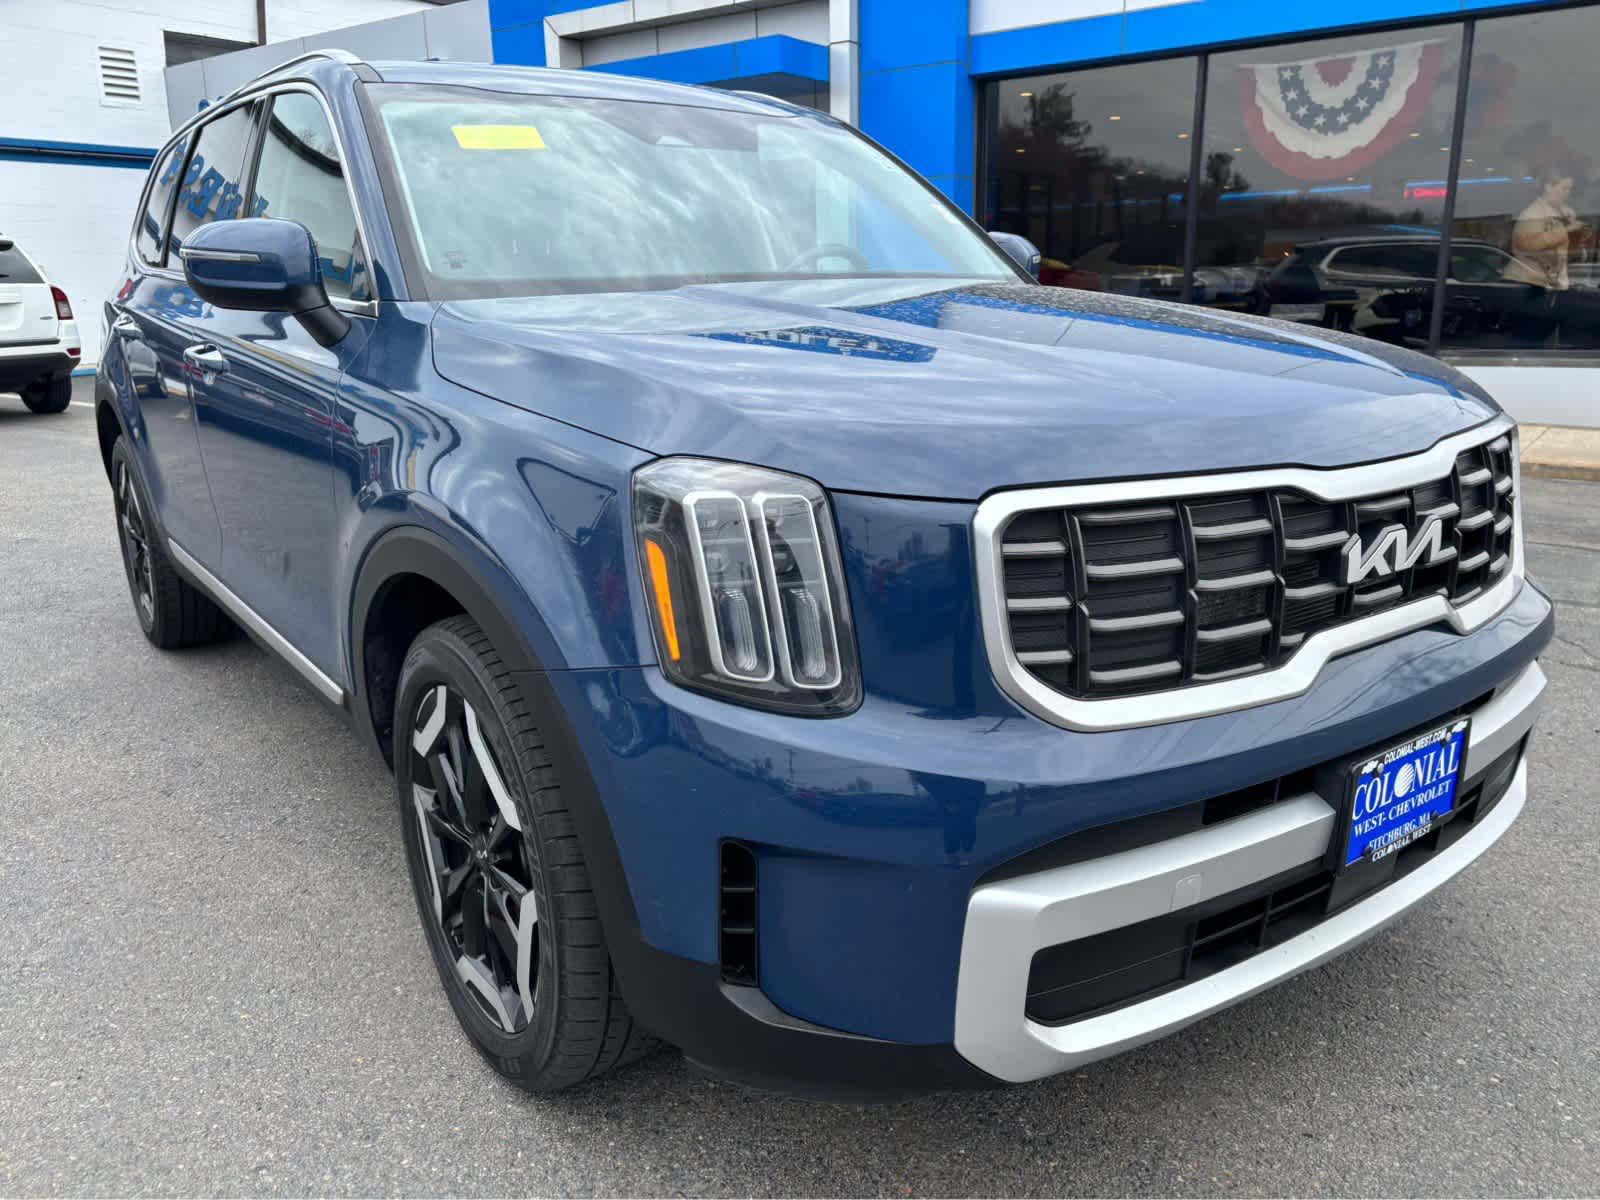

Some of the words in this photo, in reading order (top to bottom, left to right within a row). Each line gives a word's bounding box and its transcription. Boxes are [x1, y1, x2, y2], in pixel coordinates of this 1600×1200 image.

[1351, 741, 1460, 821] COLONIAL
[1388, 781, 1451, 821] CHEVROLET
[1412, 823, 1433, 841] WEST
